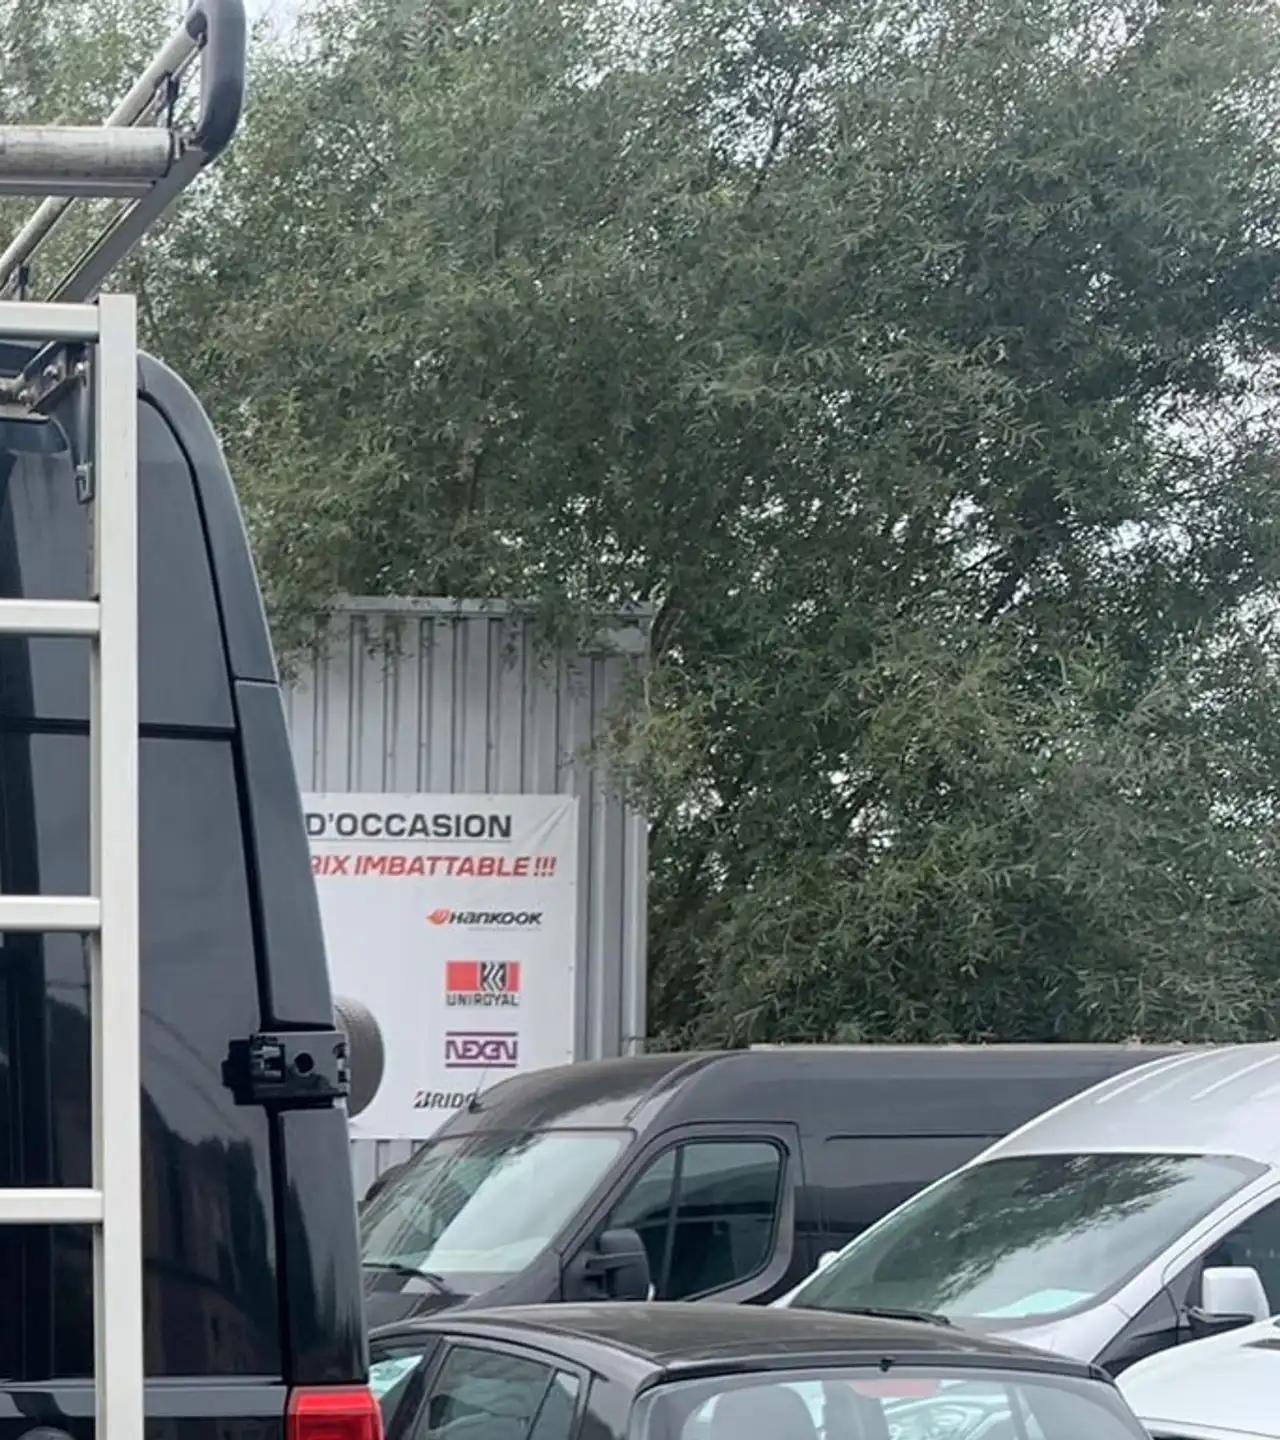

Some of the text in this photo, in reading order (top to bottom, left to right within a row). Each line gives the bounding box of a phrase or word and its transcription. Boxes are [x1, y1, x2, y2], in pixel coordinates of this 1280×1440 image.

[306, 812, 512, 837] D'OCCASION
[354, 855, 530, 877] IMBATTABLE
[446, 993, 519, 1006] UNIROYAL
[445, 1040, 518, 1060] NEXEN
